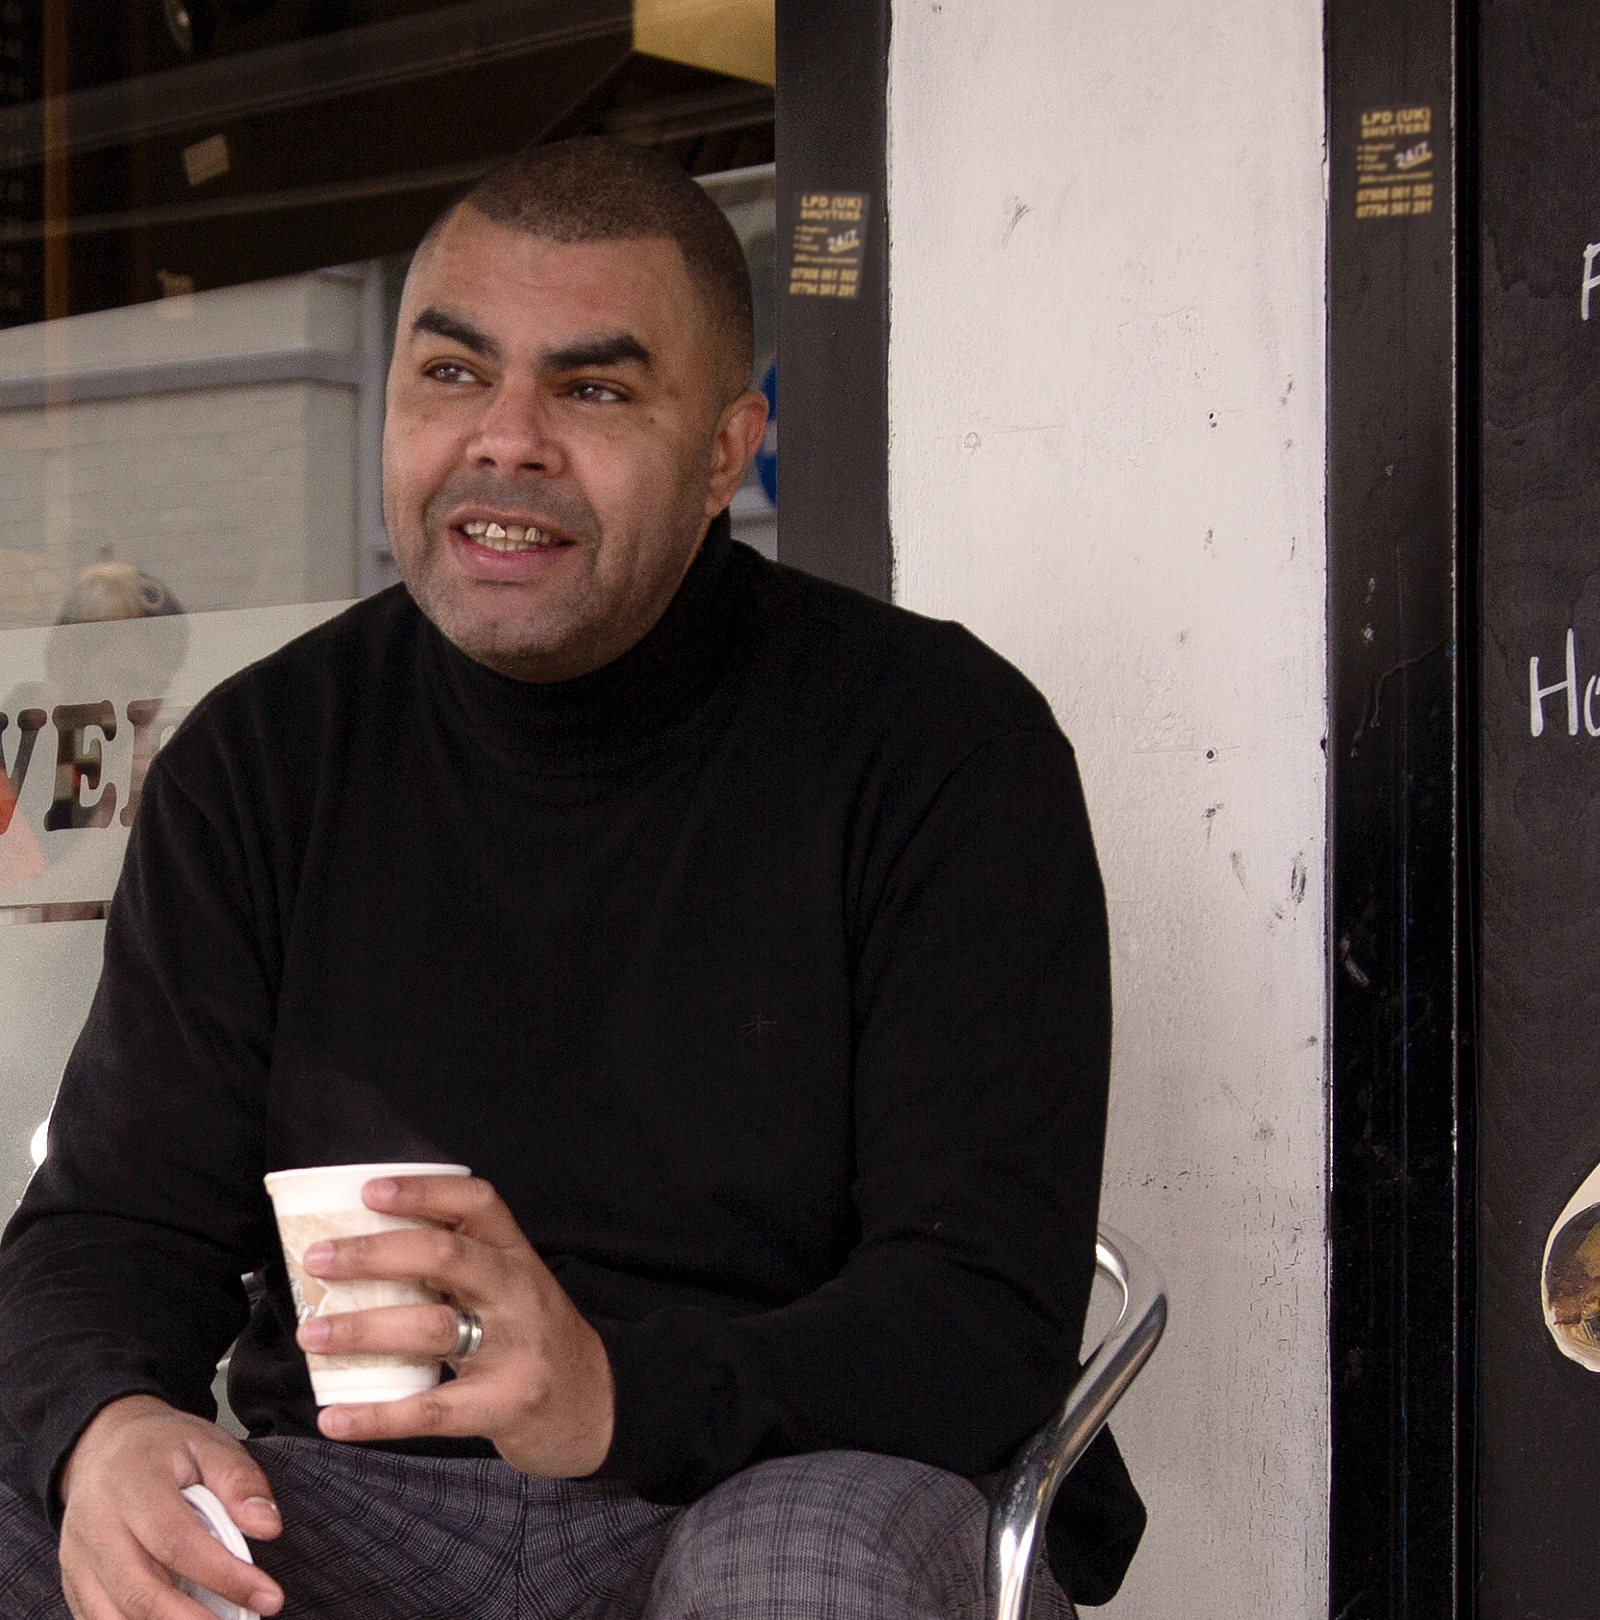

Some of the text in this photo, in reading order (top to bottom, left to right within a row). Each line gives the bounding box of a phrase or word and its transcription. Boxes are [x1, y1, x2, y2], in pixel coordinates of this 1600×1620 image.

[1362, 107, 1431, 126] LPD (UK)
[1362, 121, 1431, 138] SHUTTERS
[801, 196, 862, 210] LPD (UK)
[801, 209, 861, 221] SHUTTERS
